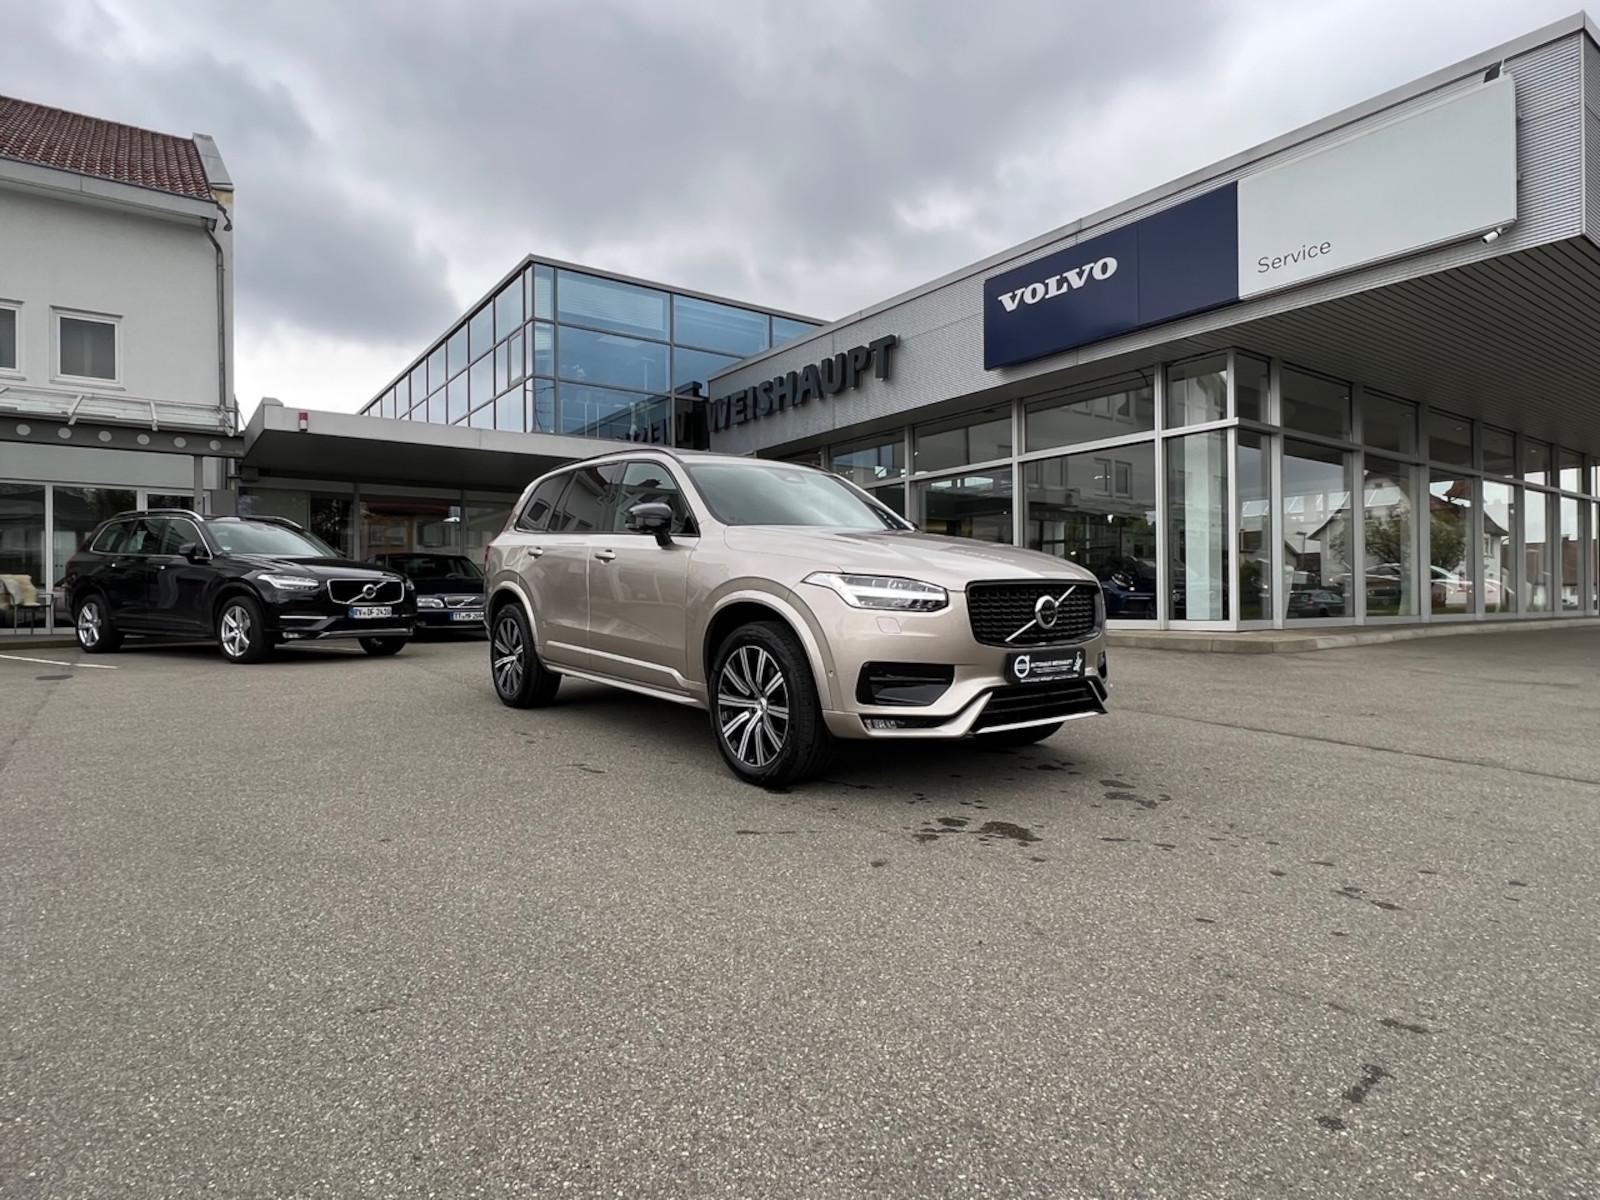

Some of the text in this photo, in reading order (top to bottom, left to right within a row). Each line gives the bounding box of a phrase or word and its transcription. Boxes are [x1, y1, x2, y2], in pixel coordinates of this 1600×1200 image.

[997, 256, 1118, 312] VOLVO
[1256, 240, 1332, 274] Service
[705, 334, 897, 433] WEISHAUPT
